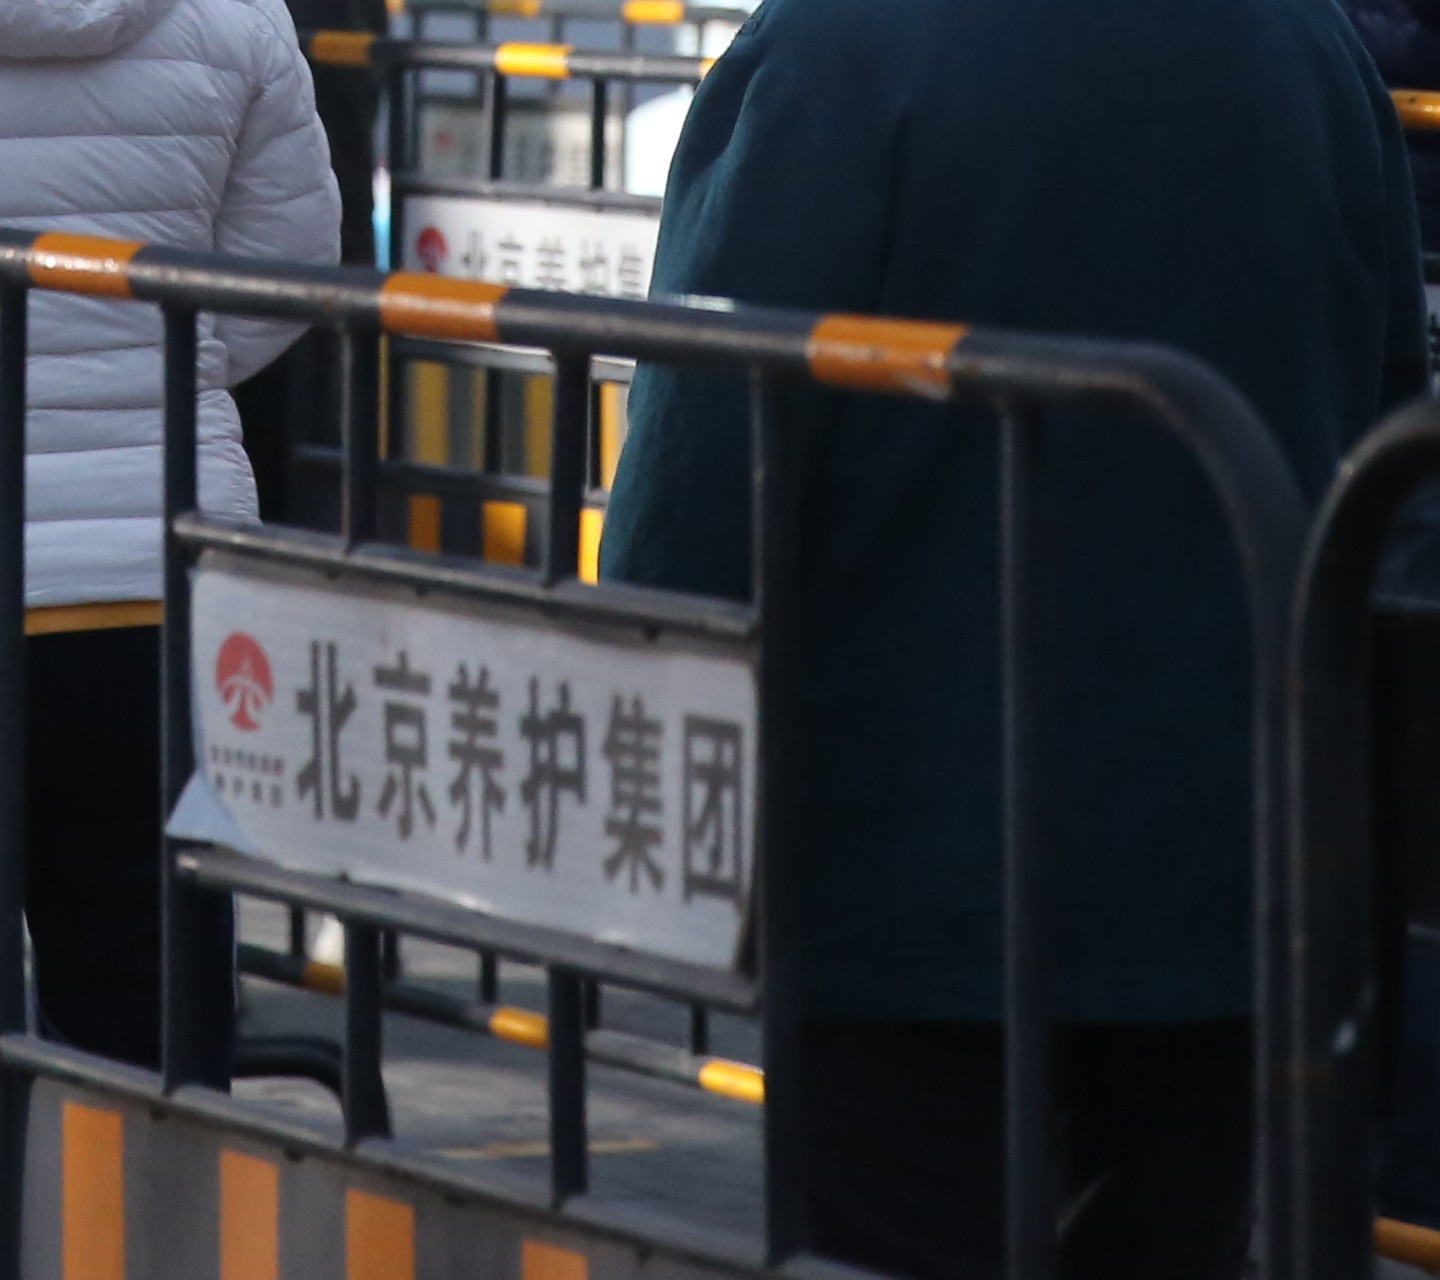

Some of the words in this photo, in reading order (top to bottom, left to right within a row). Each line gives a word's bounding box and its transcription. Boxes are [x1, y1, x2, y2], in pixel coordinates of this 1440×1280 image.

[296, 639, 745, 905] 北京养护集团
